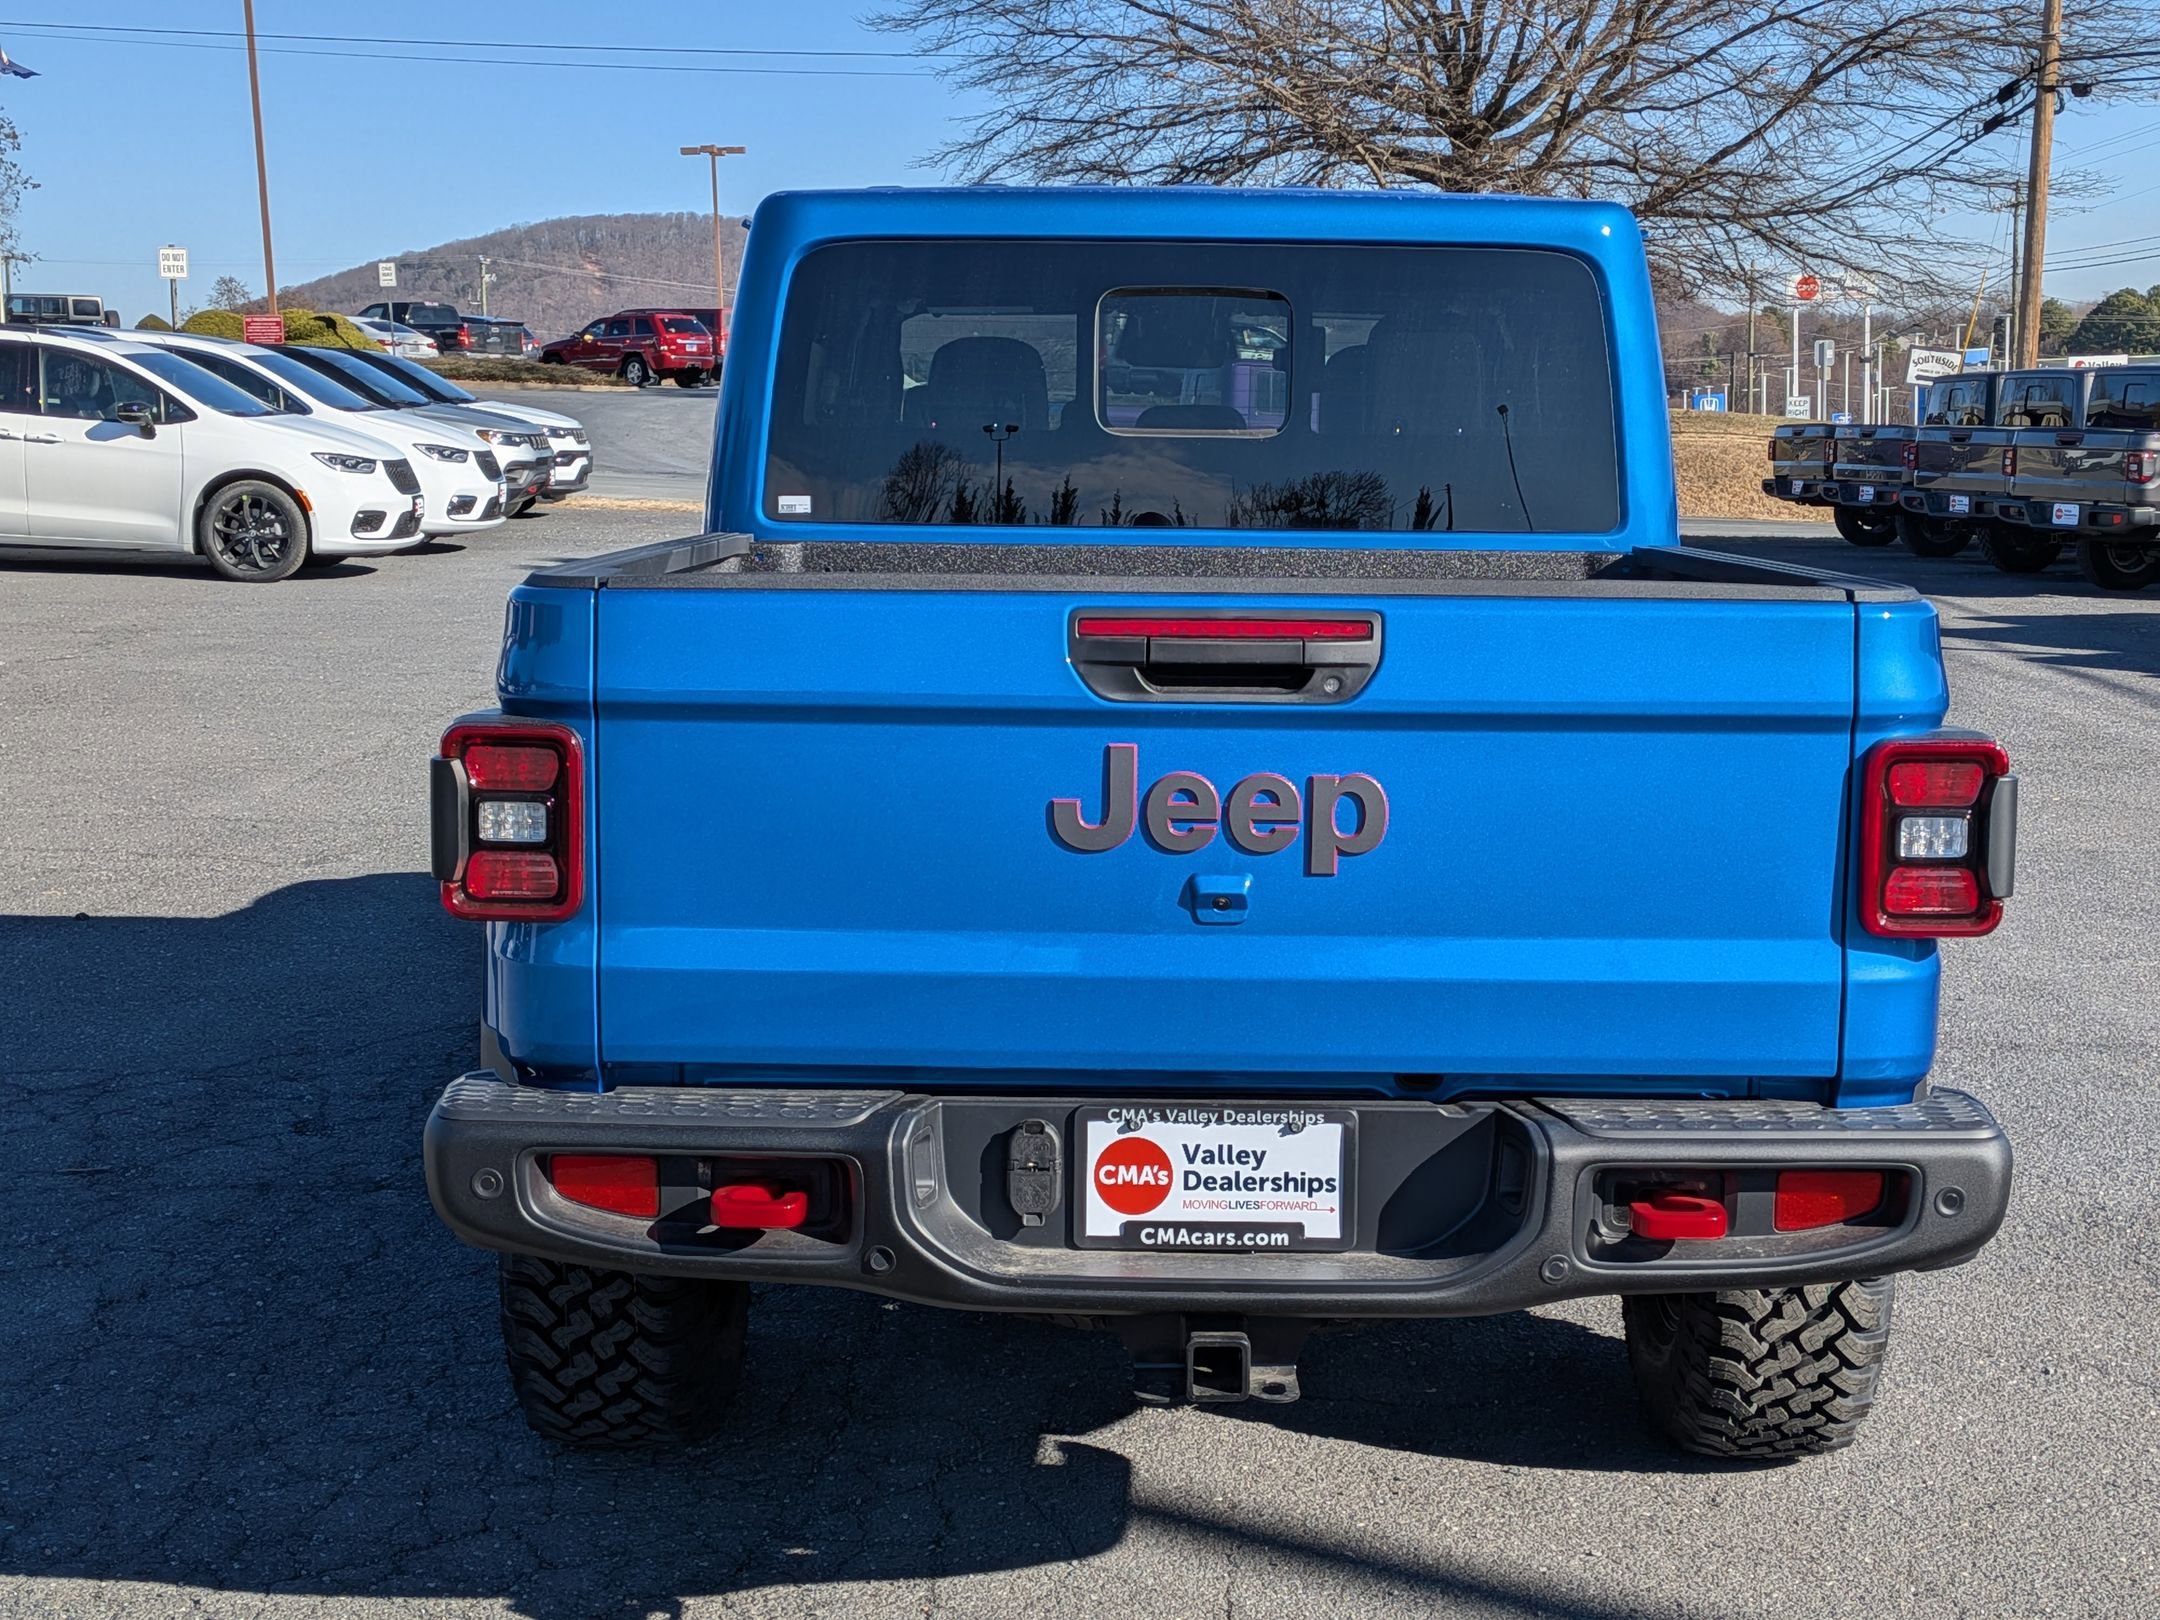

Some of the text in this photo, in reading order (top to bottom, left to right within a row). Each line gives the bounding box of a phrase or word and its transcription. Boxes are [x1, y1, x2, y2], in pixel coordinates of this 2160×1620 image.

[161, 253, 185, 262] DO NOT
[163, 264, 185, 273] ENTER
[1788, 399, 1808, 407] KEEP
[1052, 742, 1389, 875] Jeep
[1107, 1108, 1325, 1126] CMA's Valley Dealerships
[1181, 1143, 1267, 1171] Valley
[1098, 1164, 1169, 1186] CMA's
[1182, 1170, 1338, 1199] Dealerships
[1139, 1227, 1290, 1247] CMAcars.com
